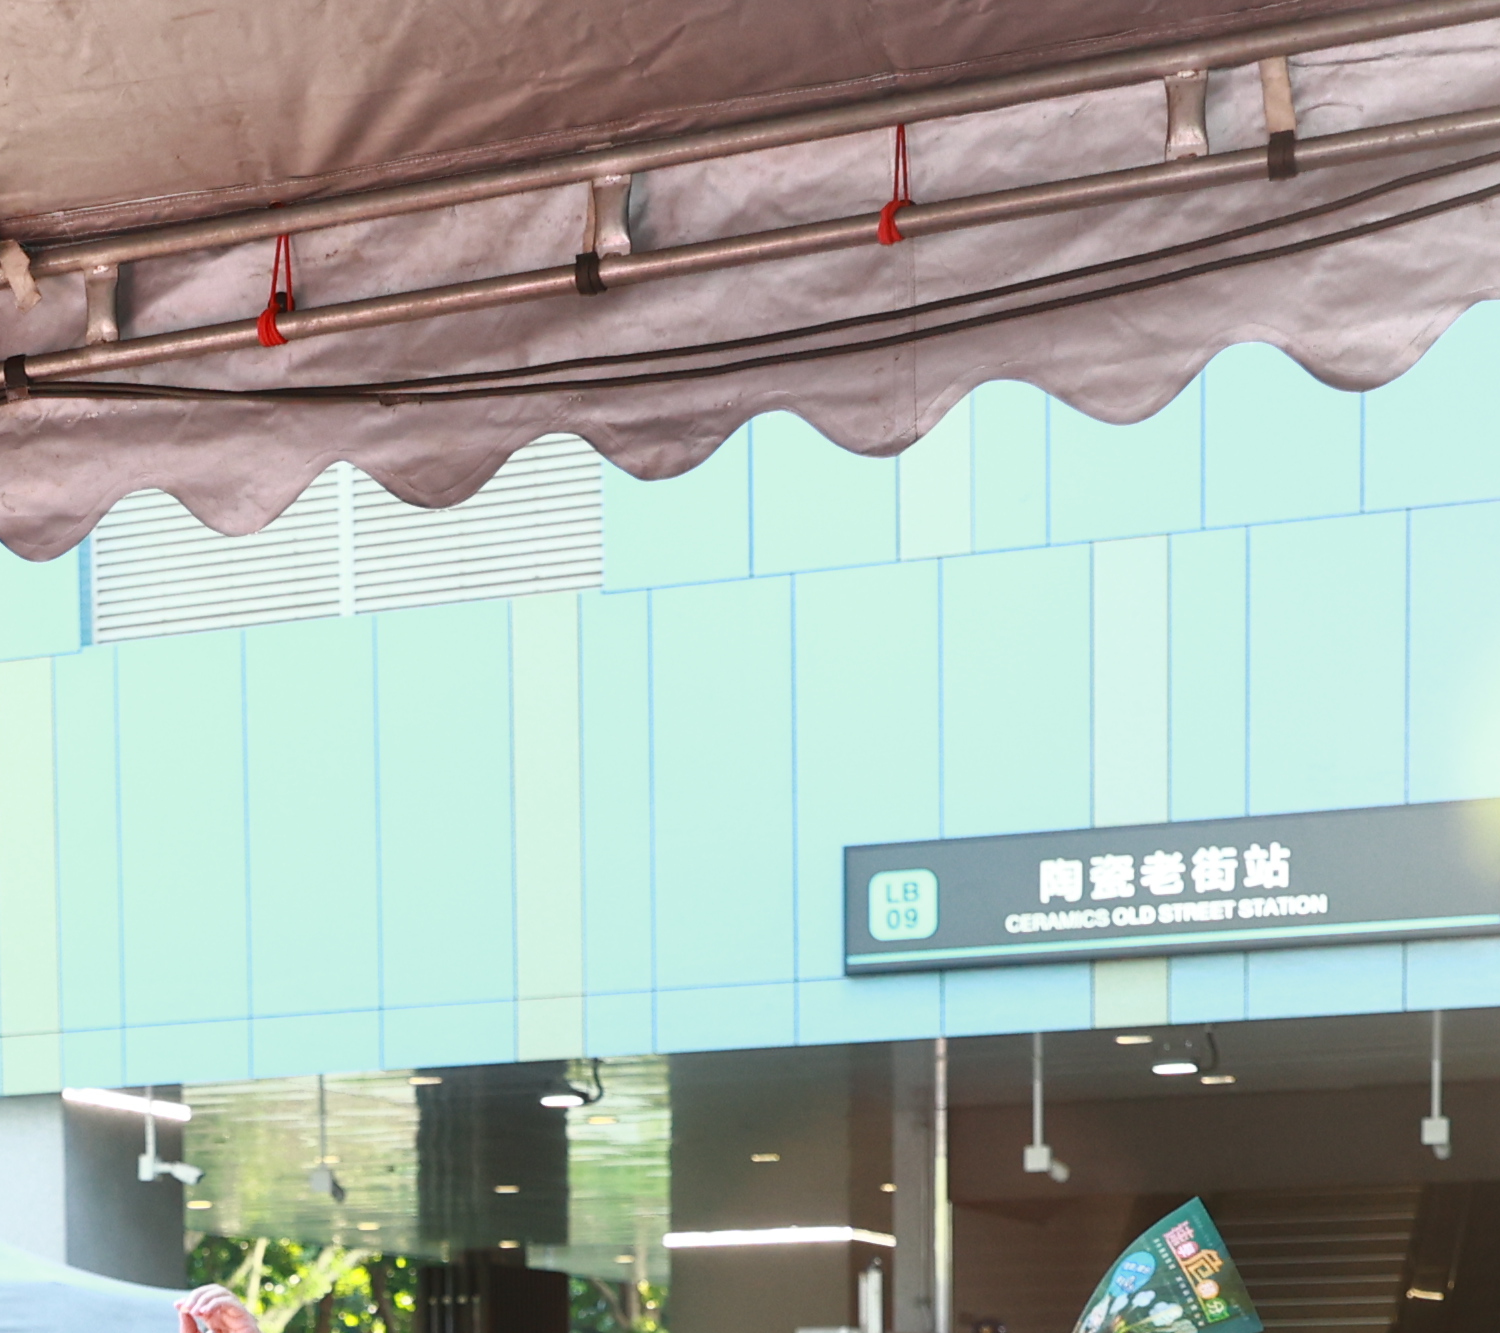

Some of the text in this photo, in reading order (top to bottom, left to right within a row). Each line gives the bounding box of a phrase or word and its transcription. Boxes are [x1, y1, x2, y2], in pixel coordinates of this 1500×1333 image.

[1039, 842, 1291, 903] 陶瓷老街站
[885, 882, 920, 904] LB
[886, 908, 918, 930] 09
[1005, 894, 1328, 933] CERAMICS OLD STREET STATION
